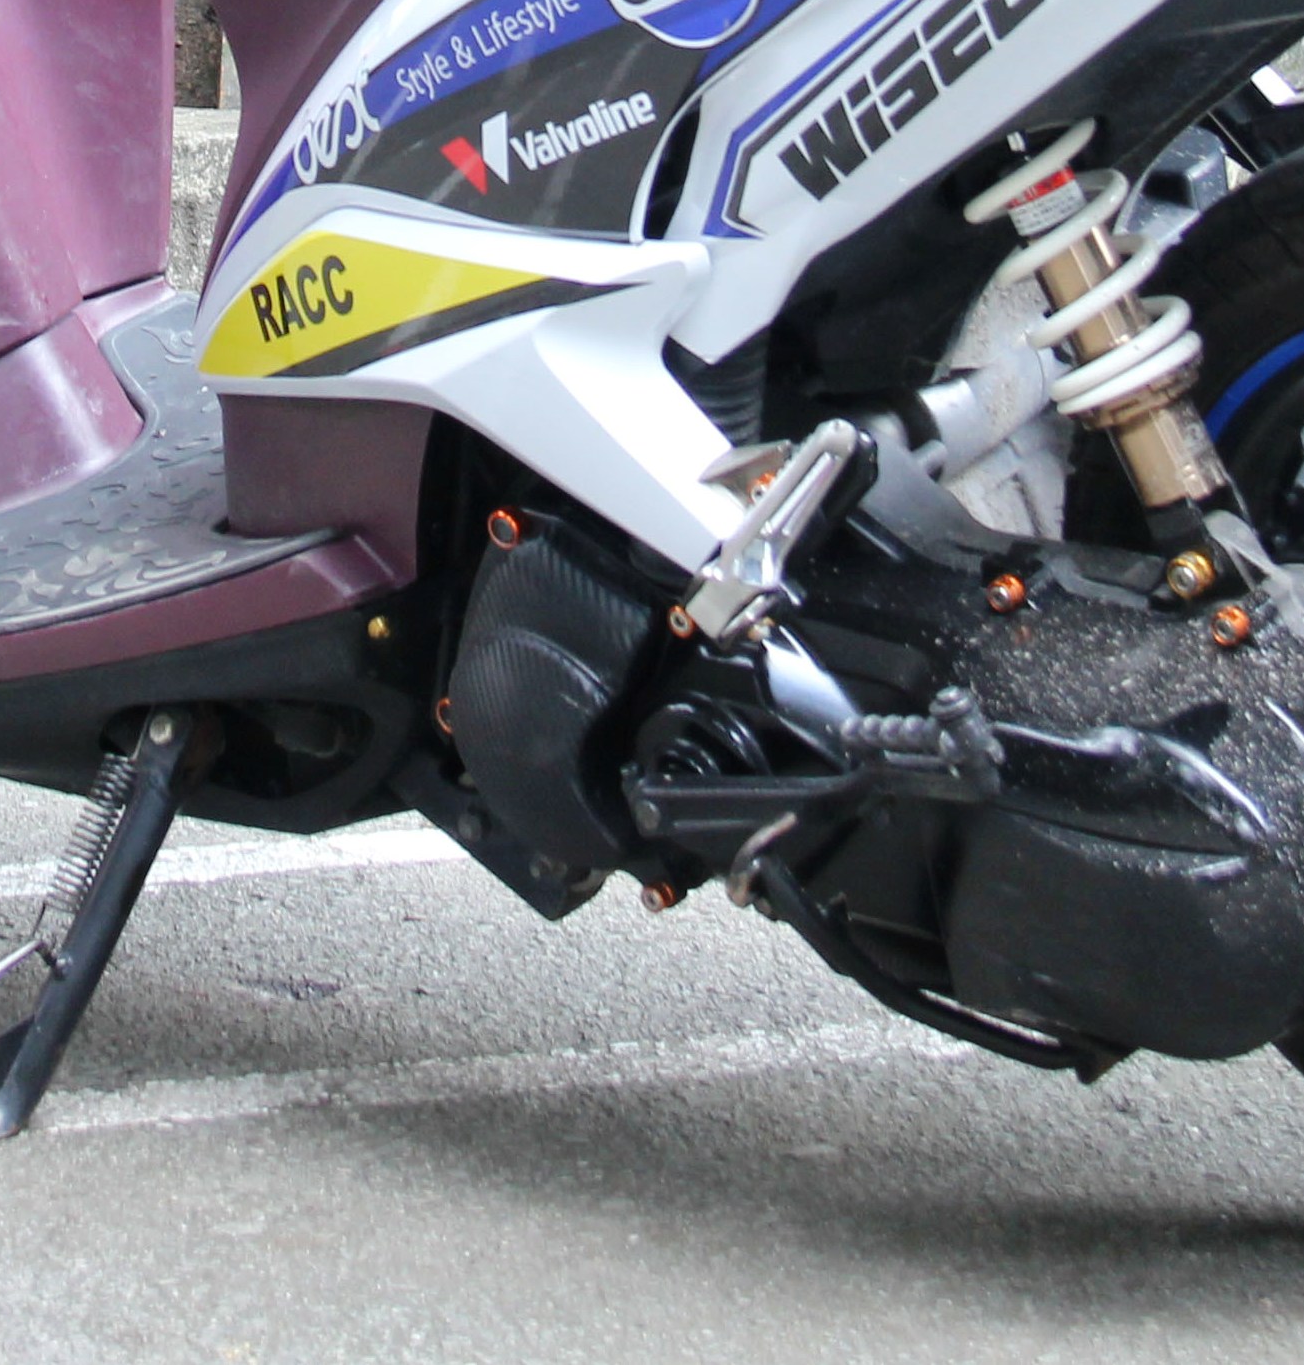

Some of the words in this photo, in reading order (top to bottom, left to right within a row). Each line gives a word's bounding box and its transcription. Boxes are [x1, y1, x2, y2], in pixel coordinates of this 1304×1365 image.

[396, 50, 453, 102] Style
[450, 35, 477, 69] &
[509, 91, 657, 172] Valvoline
[250, 254, 354, 343] RACC
